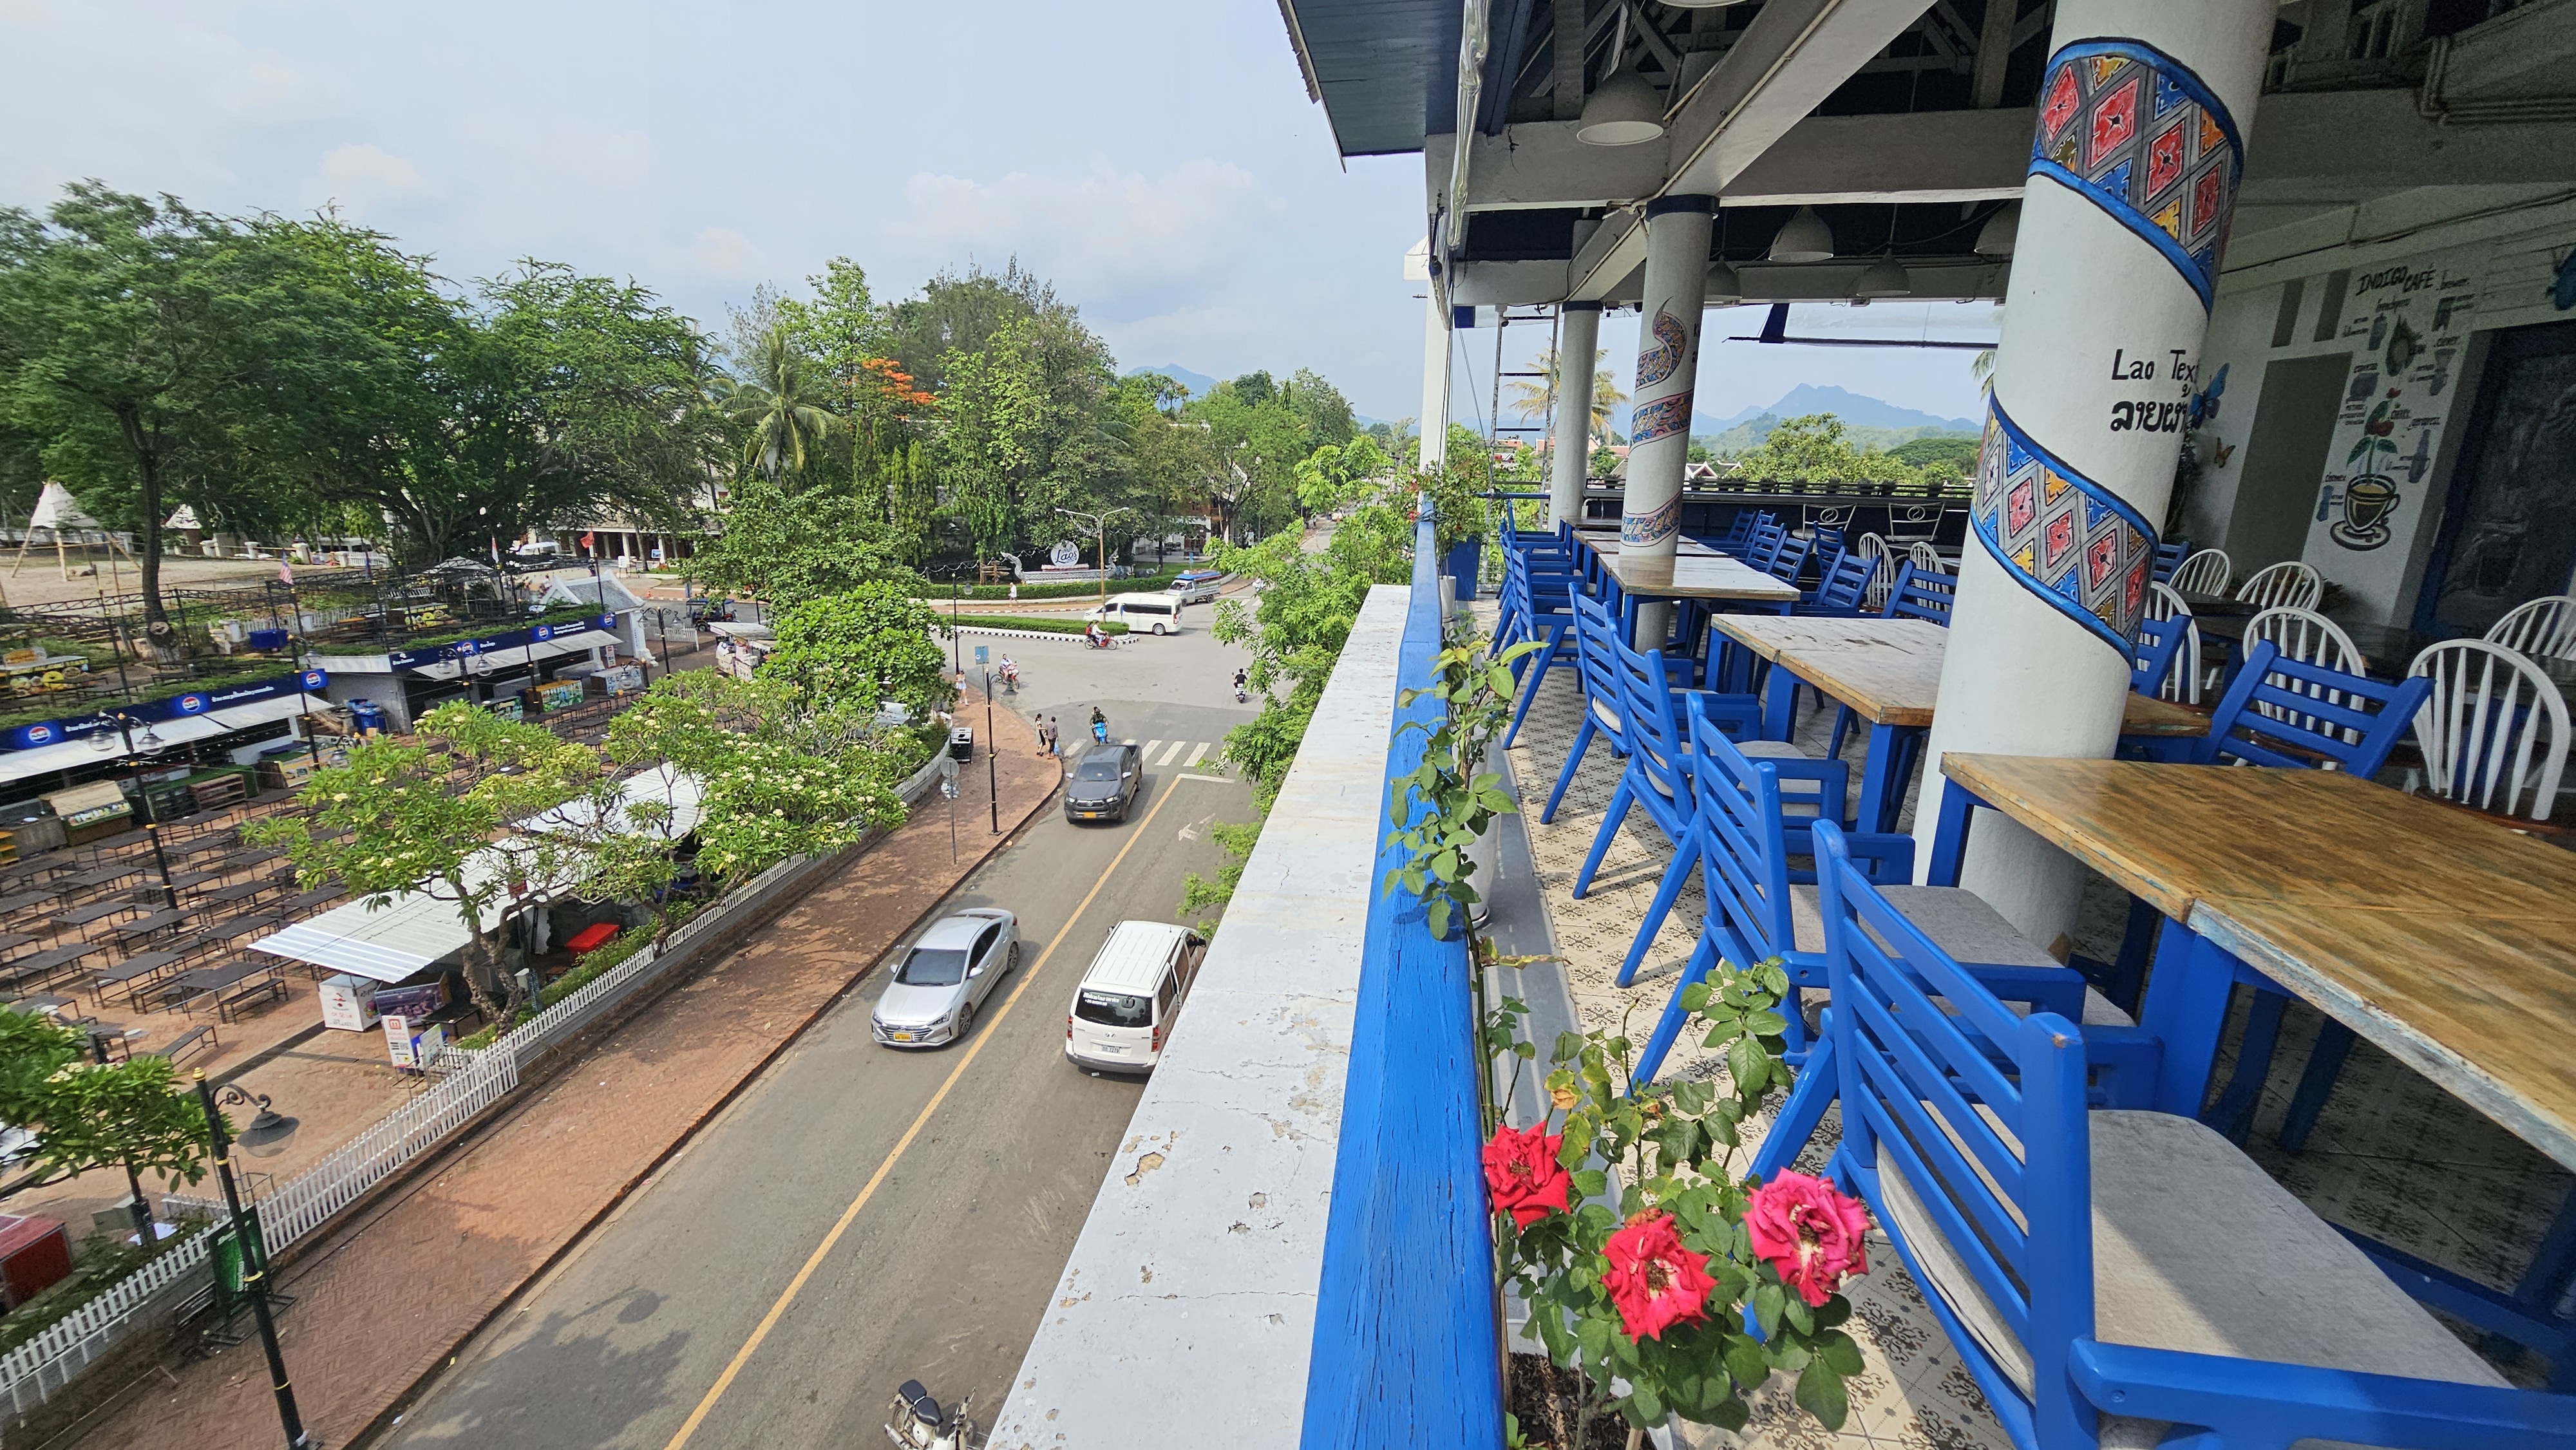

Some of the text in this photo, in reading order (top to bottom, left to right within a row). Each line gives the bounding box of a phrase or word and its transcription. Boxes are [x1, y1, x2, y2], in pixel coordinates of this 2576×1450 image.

[2356, 265, 2409, 296] INDIGO
[2403, 261, 2437, 294] CAFÉ
[2111, 348, 2155, 380] Lao
[1055, 549, 1077, 563] Laos
